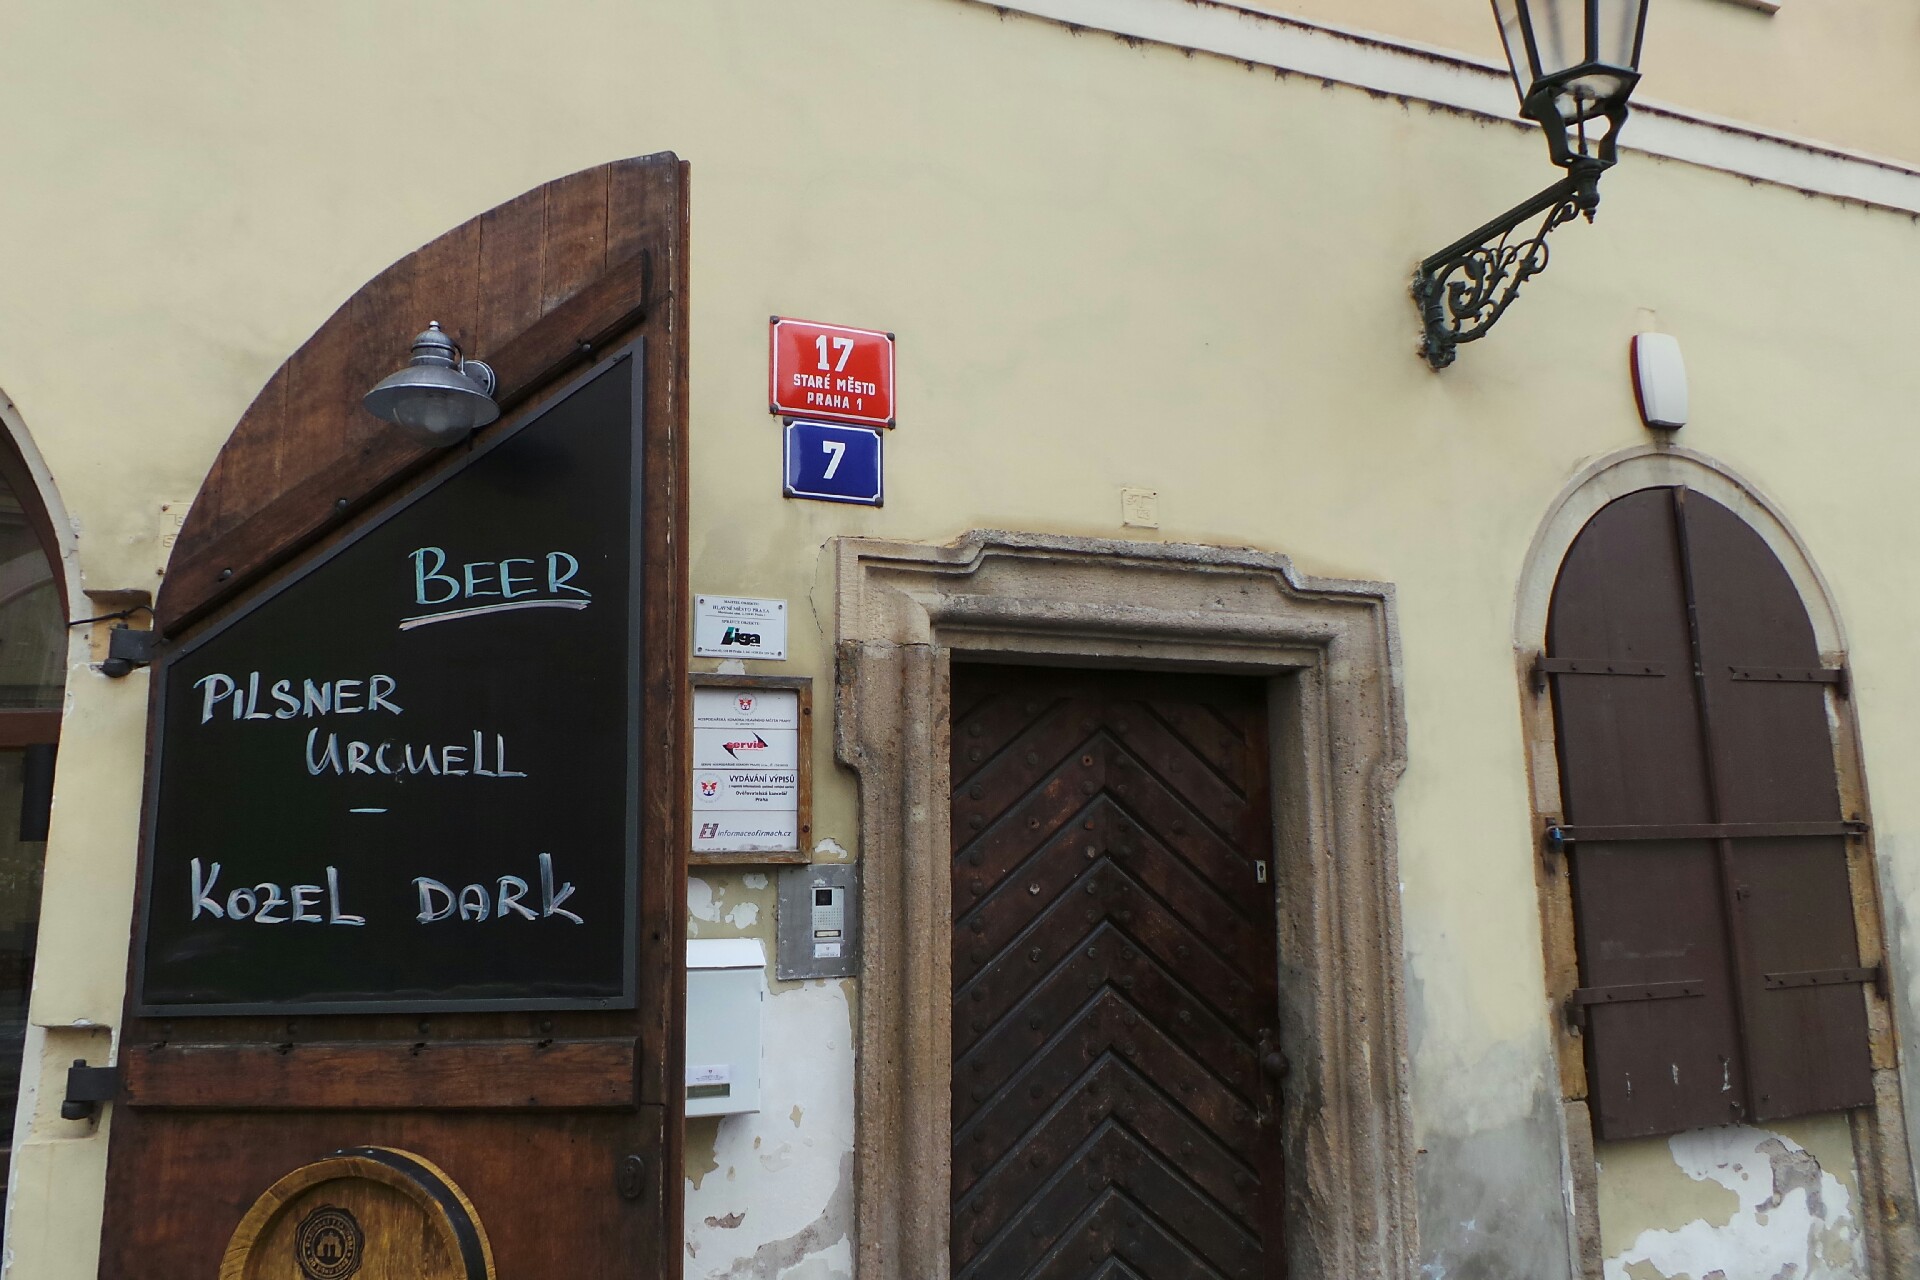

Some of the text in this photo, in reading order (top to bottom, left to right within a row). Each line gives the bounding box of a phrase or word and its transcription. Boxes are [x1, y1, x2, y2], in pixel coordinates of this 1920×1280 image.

[815, 334, 854, 372] 17
[793, 373, 876, 396] STARÉ MĚSTO
[807, 391, 862, 411] PRAHA 1
[822, 440, 846, 480] 7
[408, 546, 592, 605] BEER
[193, 671, 404, 724] PILSNER
[729, 774, 795, 783] VYDÁVÁNÍ VÝPISŮ
[191, 852, 584, 926] KOZEL DARK
